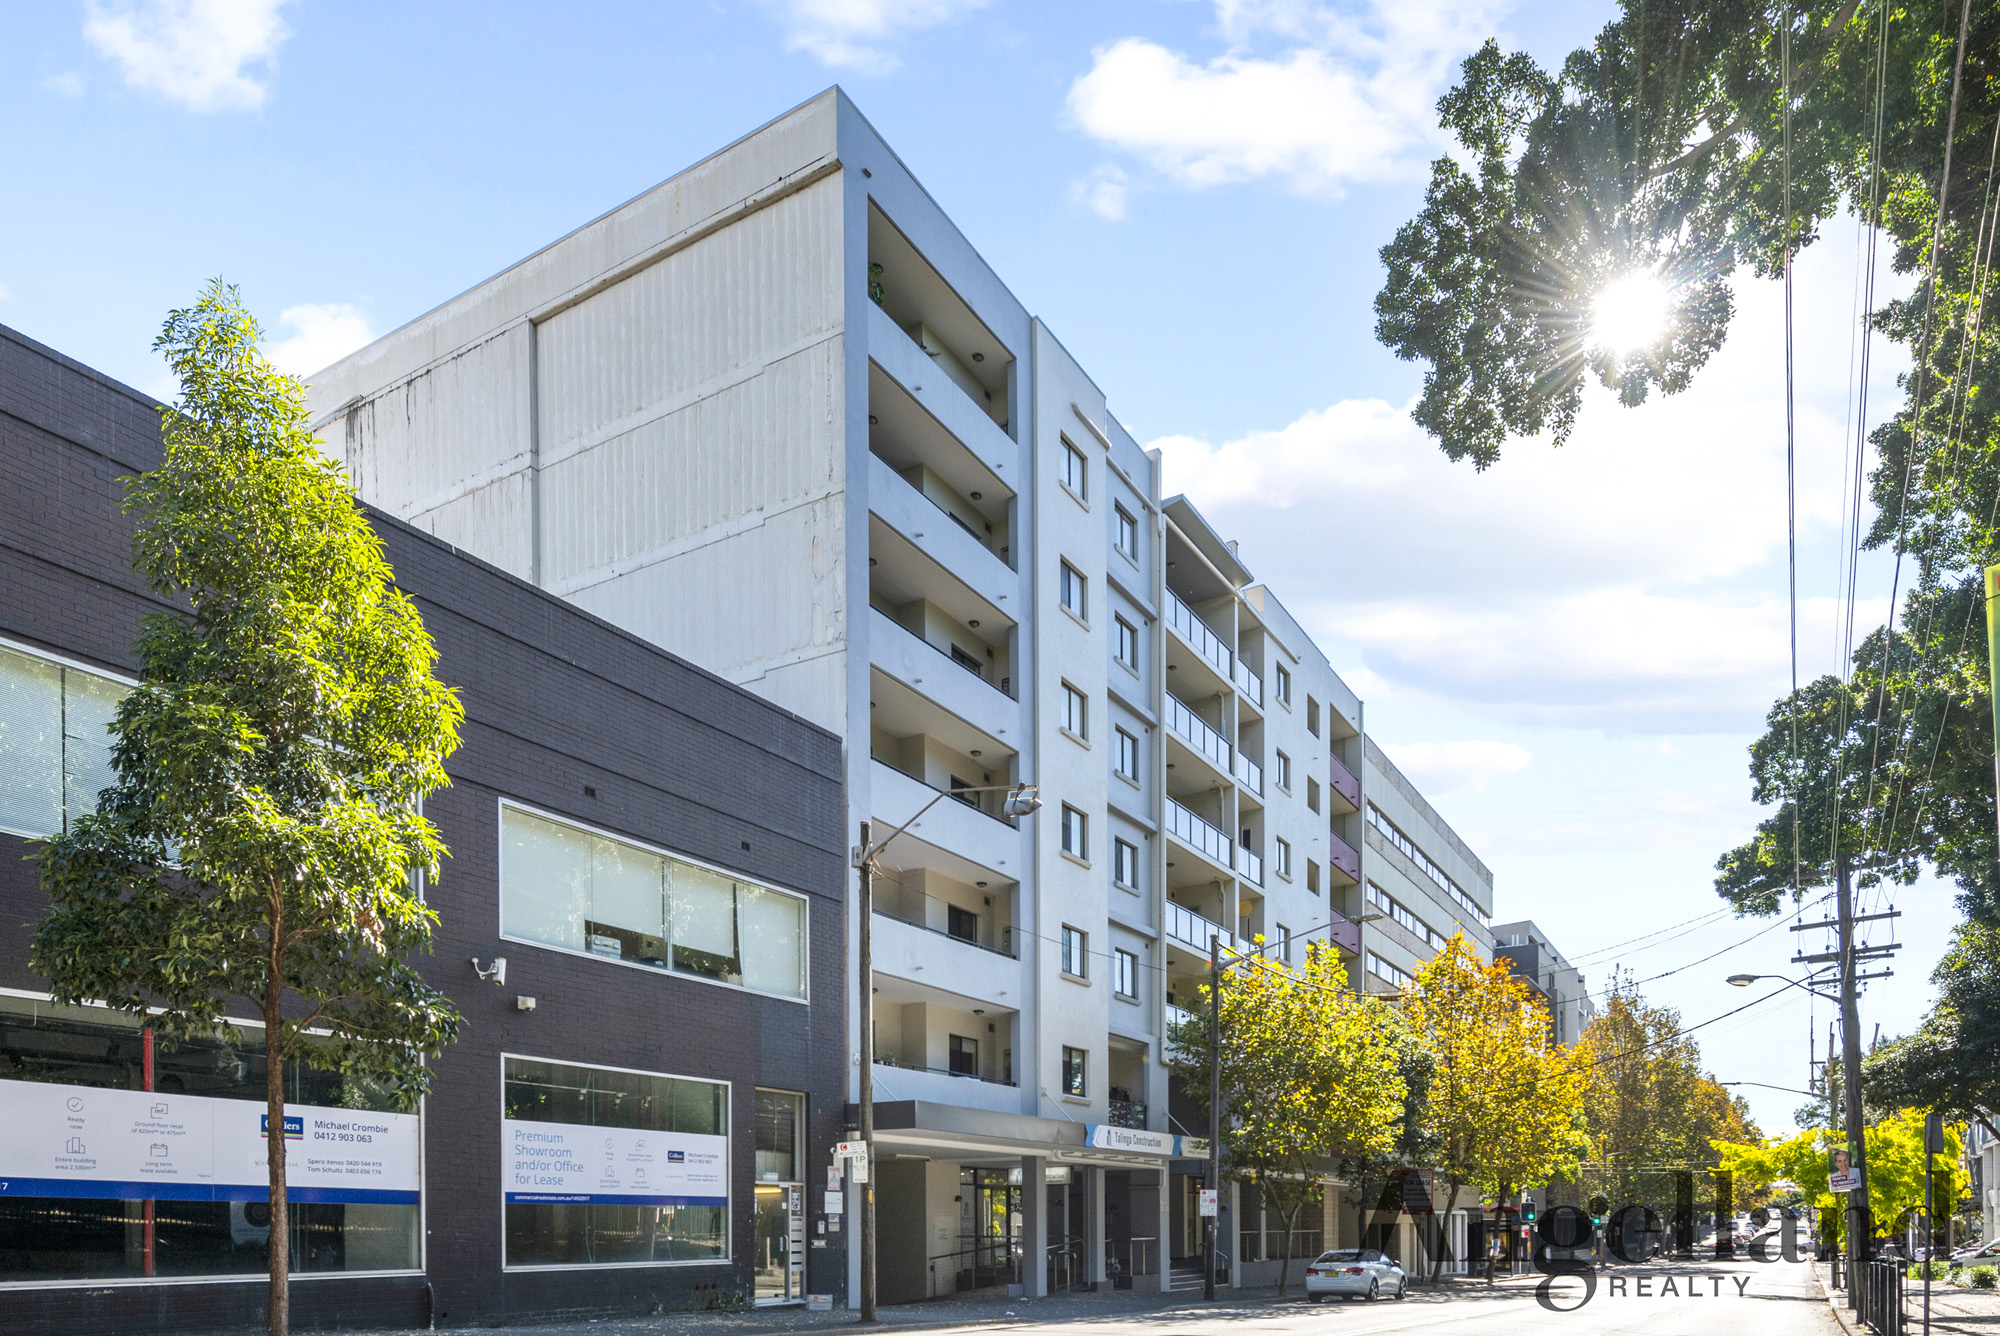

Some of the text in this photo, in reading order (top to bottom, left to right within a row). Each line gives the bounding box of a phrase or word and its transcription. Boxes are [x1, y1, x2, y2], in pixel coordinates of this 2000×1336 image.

[67, 1116, 85, 1124] Ready
[314, 1120, 389, 1134] Michael Crombie
[314, 1132, 372, 1143] 0412 903 063
[515, 1130, 564, 1143] Premium
[1115, 1132, 1162, 1148] Talinga Construction
[515, 1144, 572, 1158] Showroom
[515, 1160, 584, 1172] and/or Office
[515, 1173, 564, 1185] for Lease
